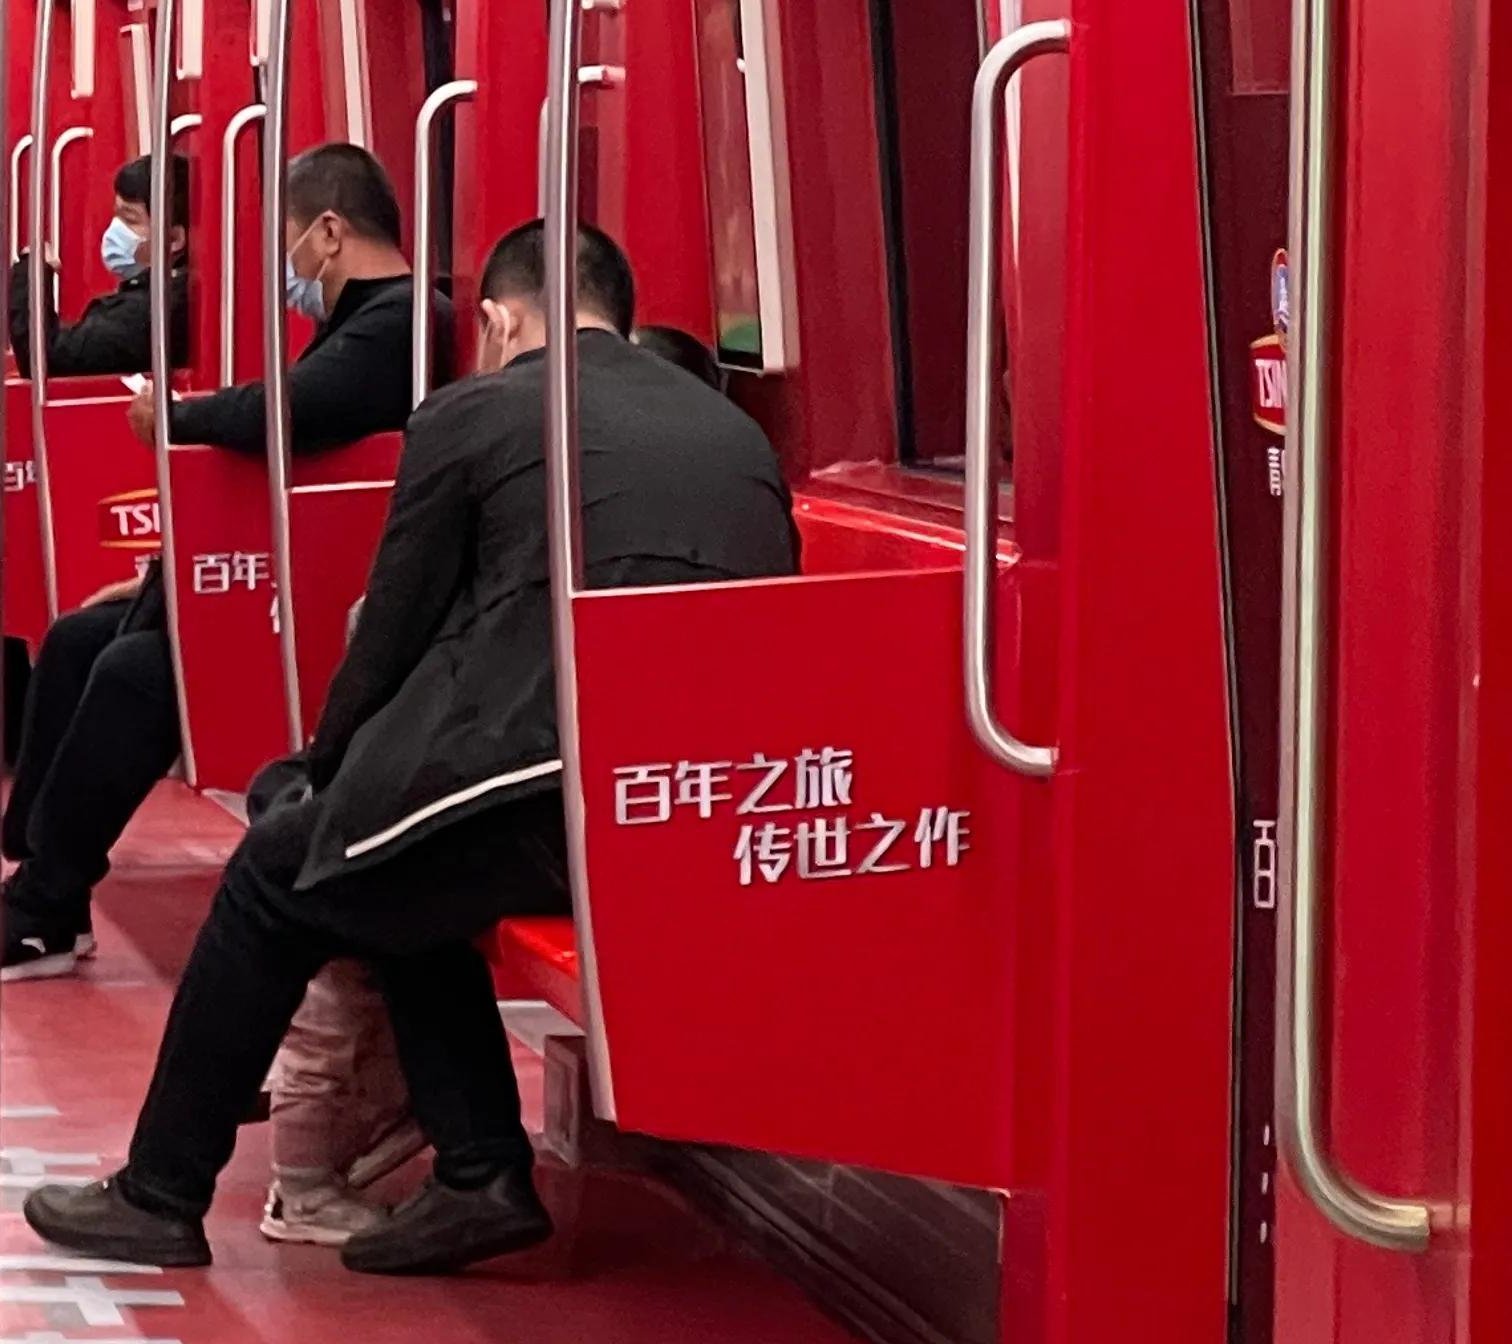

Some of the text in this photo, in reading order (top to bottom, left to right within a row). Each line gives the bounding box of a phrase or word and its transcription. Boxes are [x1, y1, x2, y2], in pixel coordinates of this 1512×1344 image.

[612, 746, 854, 825] 百年之旅
[733, 805, 971, 886] 传世之作
